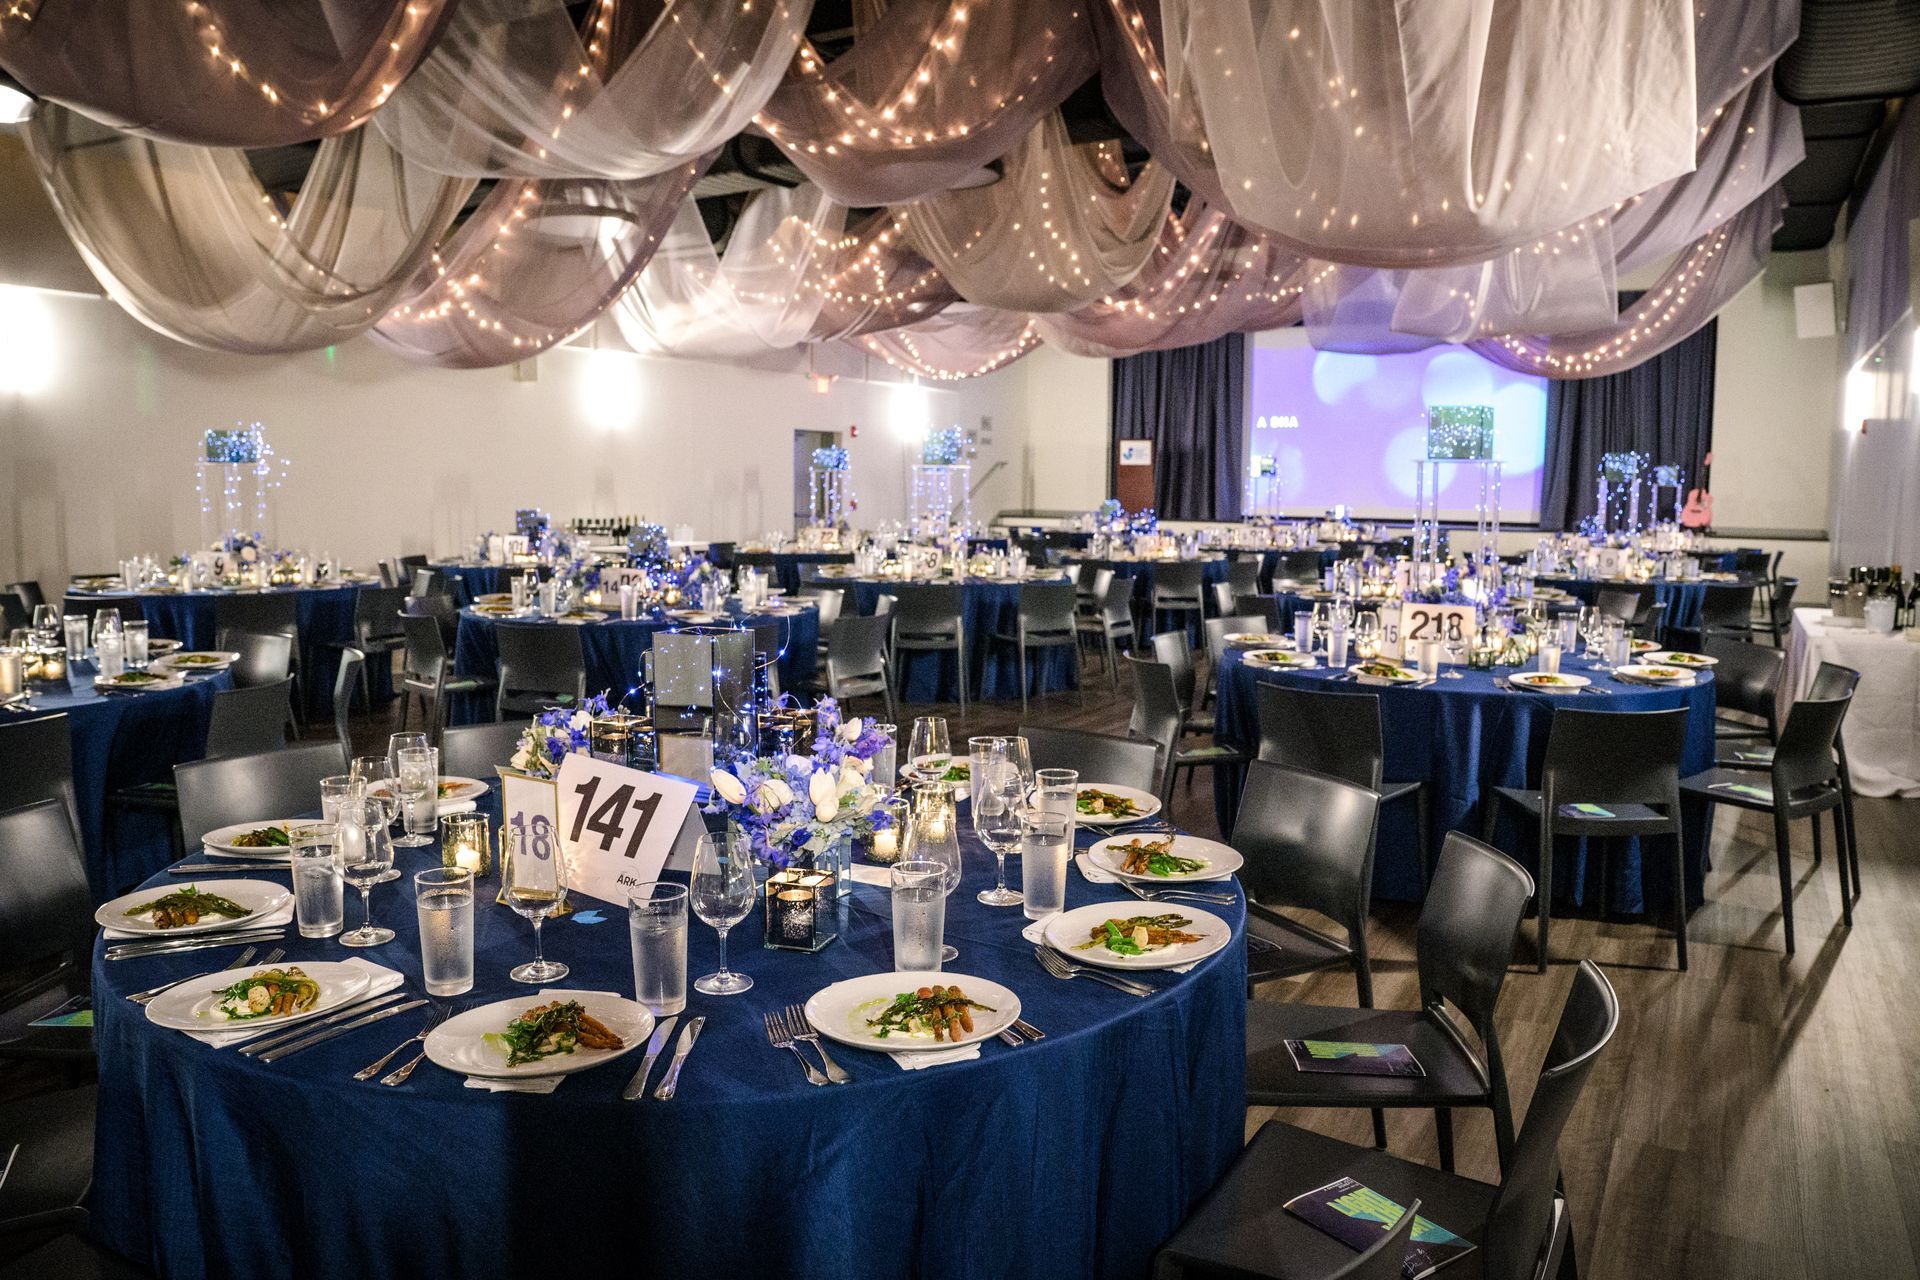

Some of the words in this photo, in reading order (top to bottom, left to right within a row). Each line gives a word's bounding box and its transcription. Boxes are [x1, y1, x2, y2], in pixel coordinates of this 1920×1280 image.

[602, 580, 619, 594] 14
[1383, 624, 1398, 644] 15
[1409, 610, 1464, 642] 218
[570, 776, 663, 859] 141
[510, 811, 551, 861] 18
[616, 874, 638, 887] ARK
